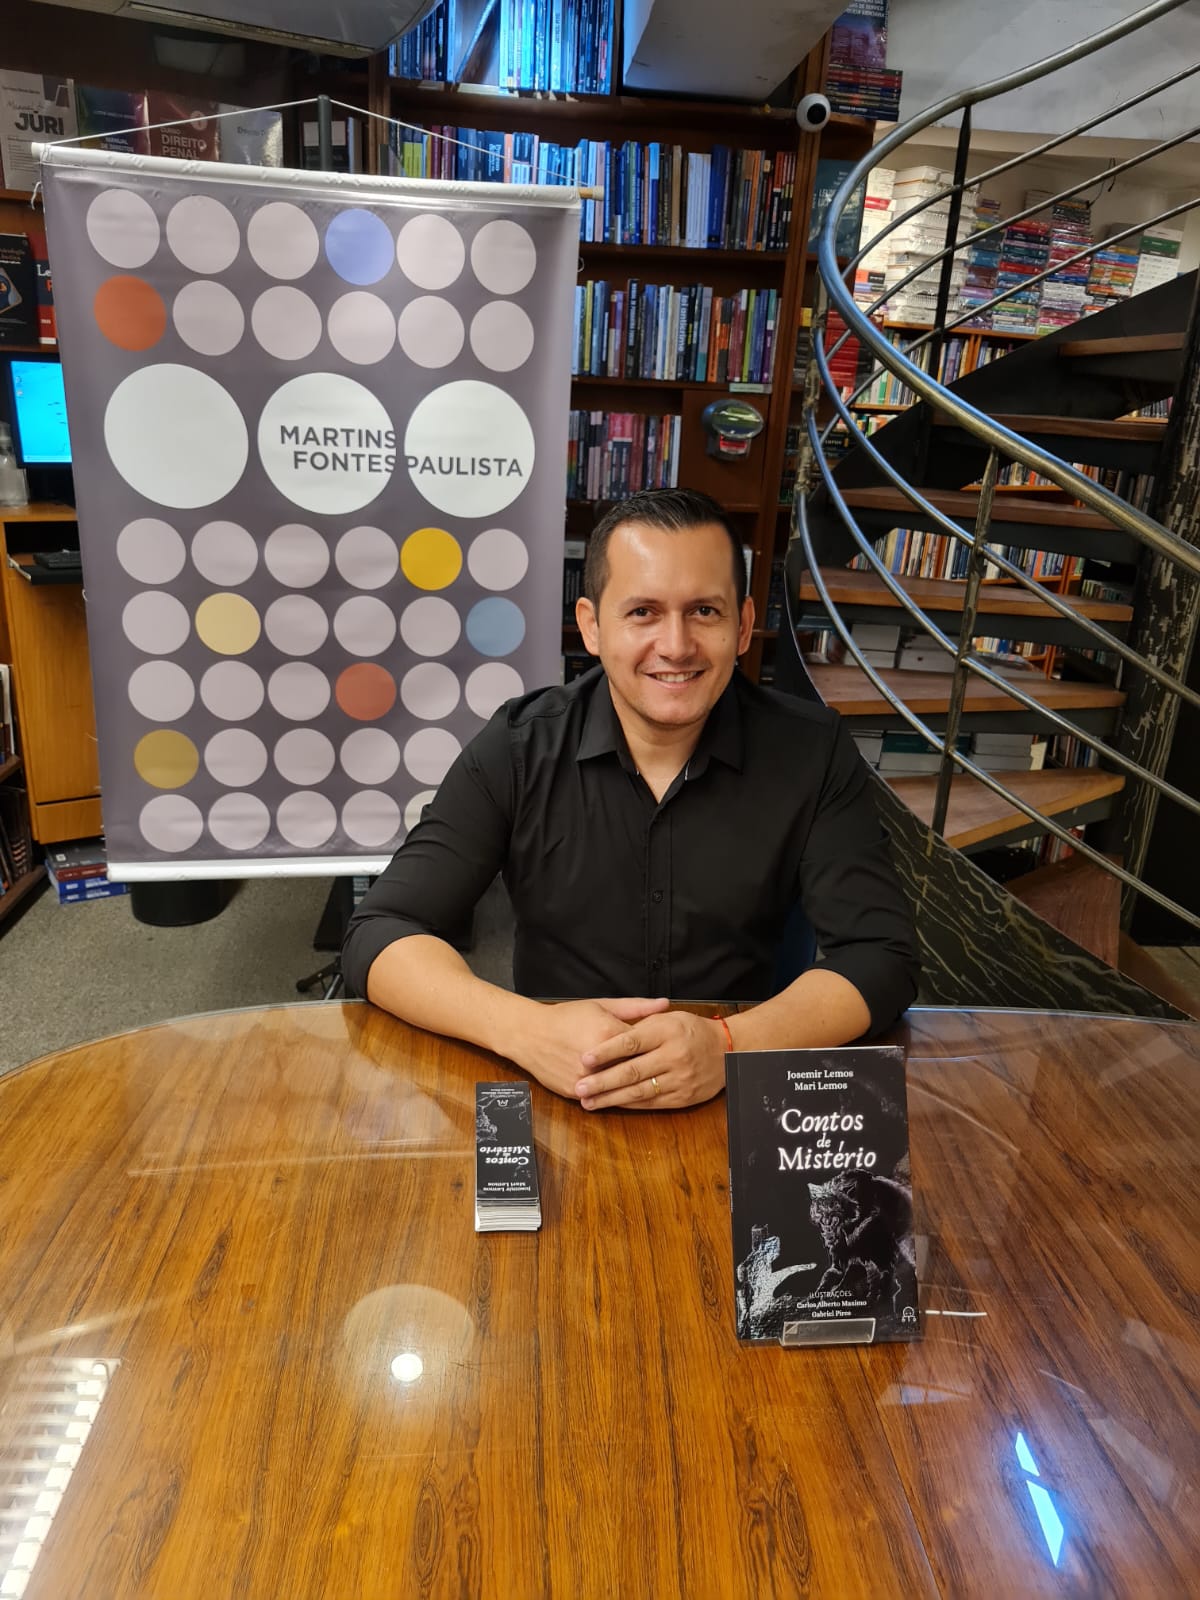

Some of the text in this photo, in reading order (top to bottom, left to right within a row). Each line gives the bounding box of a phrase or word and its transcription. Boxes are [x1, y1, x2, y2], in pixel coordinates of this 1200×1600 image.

[161, 134, 207, 152] DIREITO
[162, 147, 203, 160] PENAL
[280, 425, 397, 449] MARTINS
[293, 451, 523, 477] FONTES PAULISTA
[823, 1069, 854, 1079] Lemos
[794, 1081, 848, 1091] Mari Lemos
[781, 1108, 864, 1133] Contos
[816, 1132, 832, 1148] de
[479, 1145, 531, 1156] Mistério
[777, 1140, 877, 1170] Mistério
[485, 1156, 530, 1166] Contos
[811, 1310, 835, 1318] Gabriel
